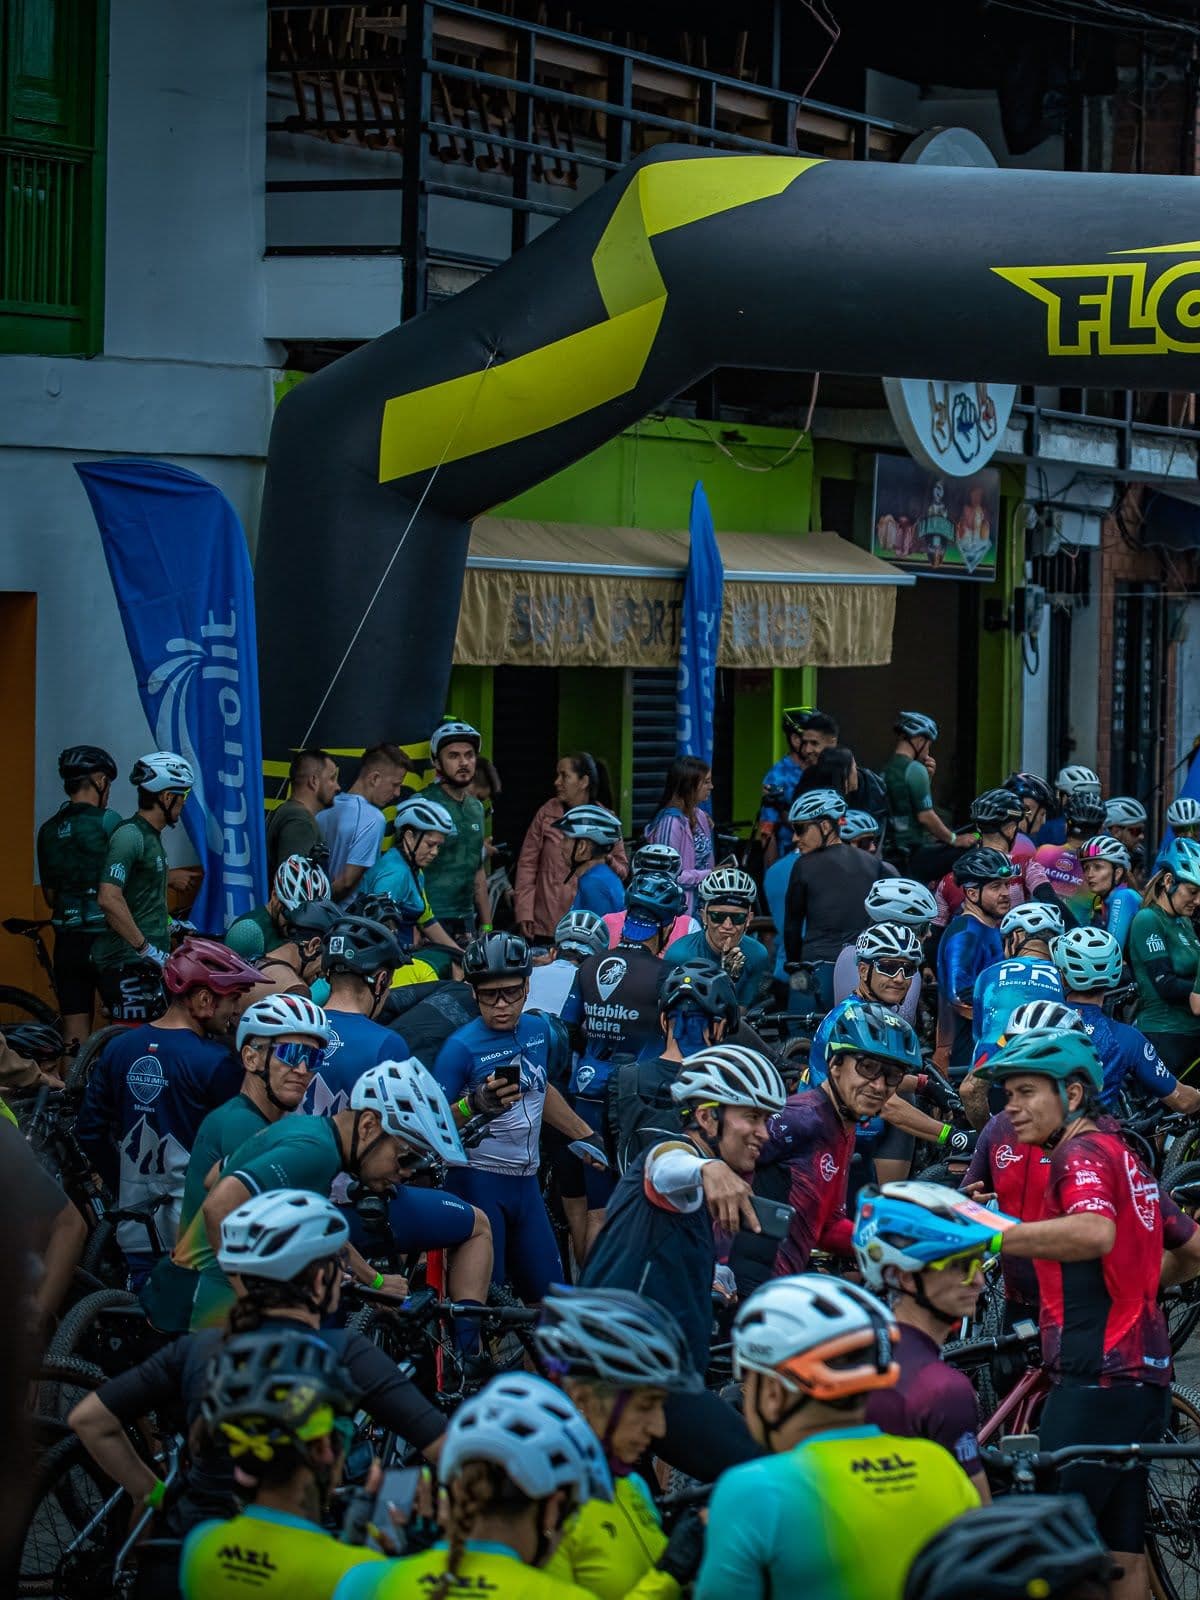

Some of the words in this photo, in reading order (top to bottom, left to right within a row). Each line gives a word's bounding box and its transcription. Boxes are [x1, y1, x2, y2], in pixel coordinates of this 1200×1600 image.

[999, 962, 1059, 985] PR
[998, 980, 1026, 988] Record
[1028, 980, 1061, 993] Personal
[588, 1017, 621, 1034] Neira
